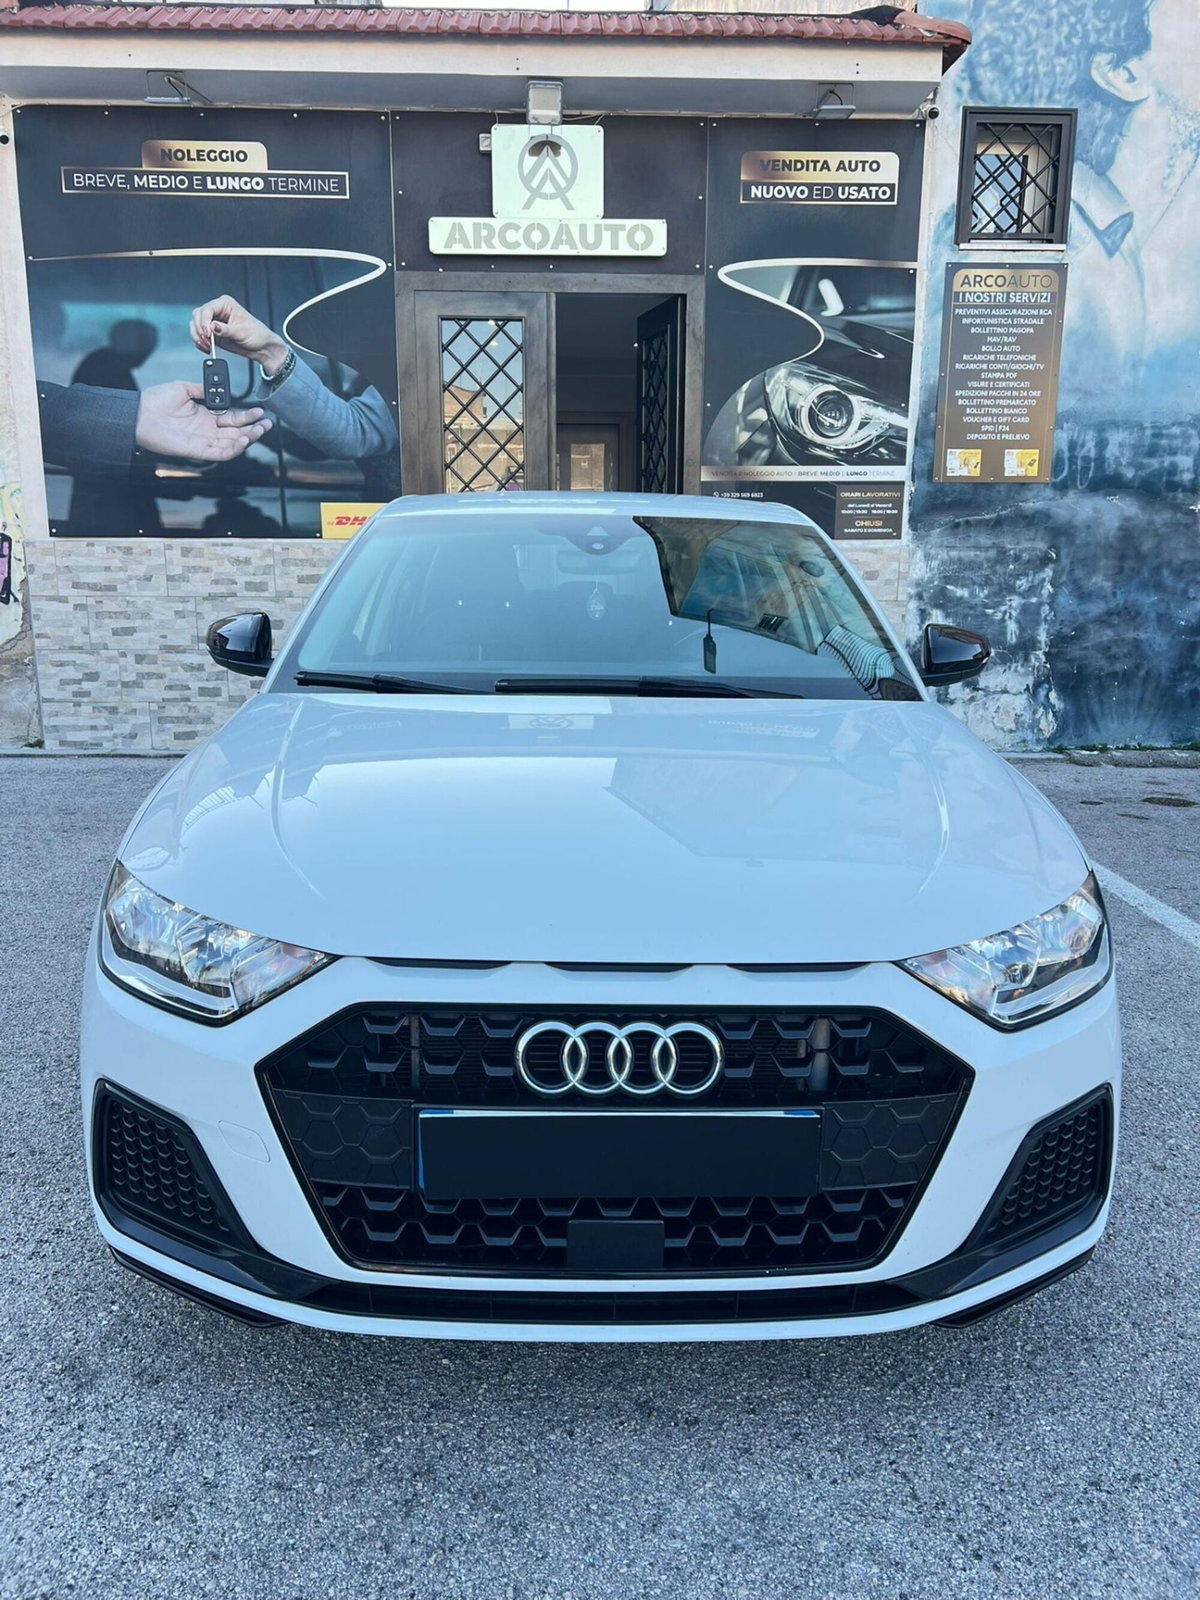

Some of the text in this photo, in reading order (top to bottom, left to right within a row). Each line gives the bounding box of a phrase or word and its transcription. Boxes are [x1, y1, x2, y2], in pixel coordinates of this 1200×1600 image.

[160, 148, 248, 162] NOLEGGIO
[760, 159, 881, 172] VENDITA AUTO
[73, 173, 340, 192] BREVE, MEDIO E LUNGO TERMINE
[750, 185, 891, 199] NUOVO ED USATO
[444, 222, 654, 251] ARCOAUTO
[960, 274, 1053, 288] ARCOAUTO
[965, 292, 1006, 302] NOSTRI
[1008, 292, 1051, 303] SERVIZI
[335, 516, 372, 525] DH
